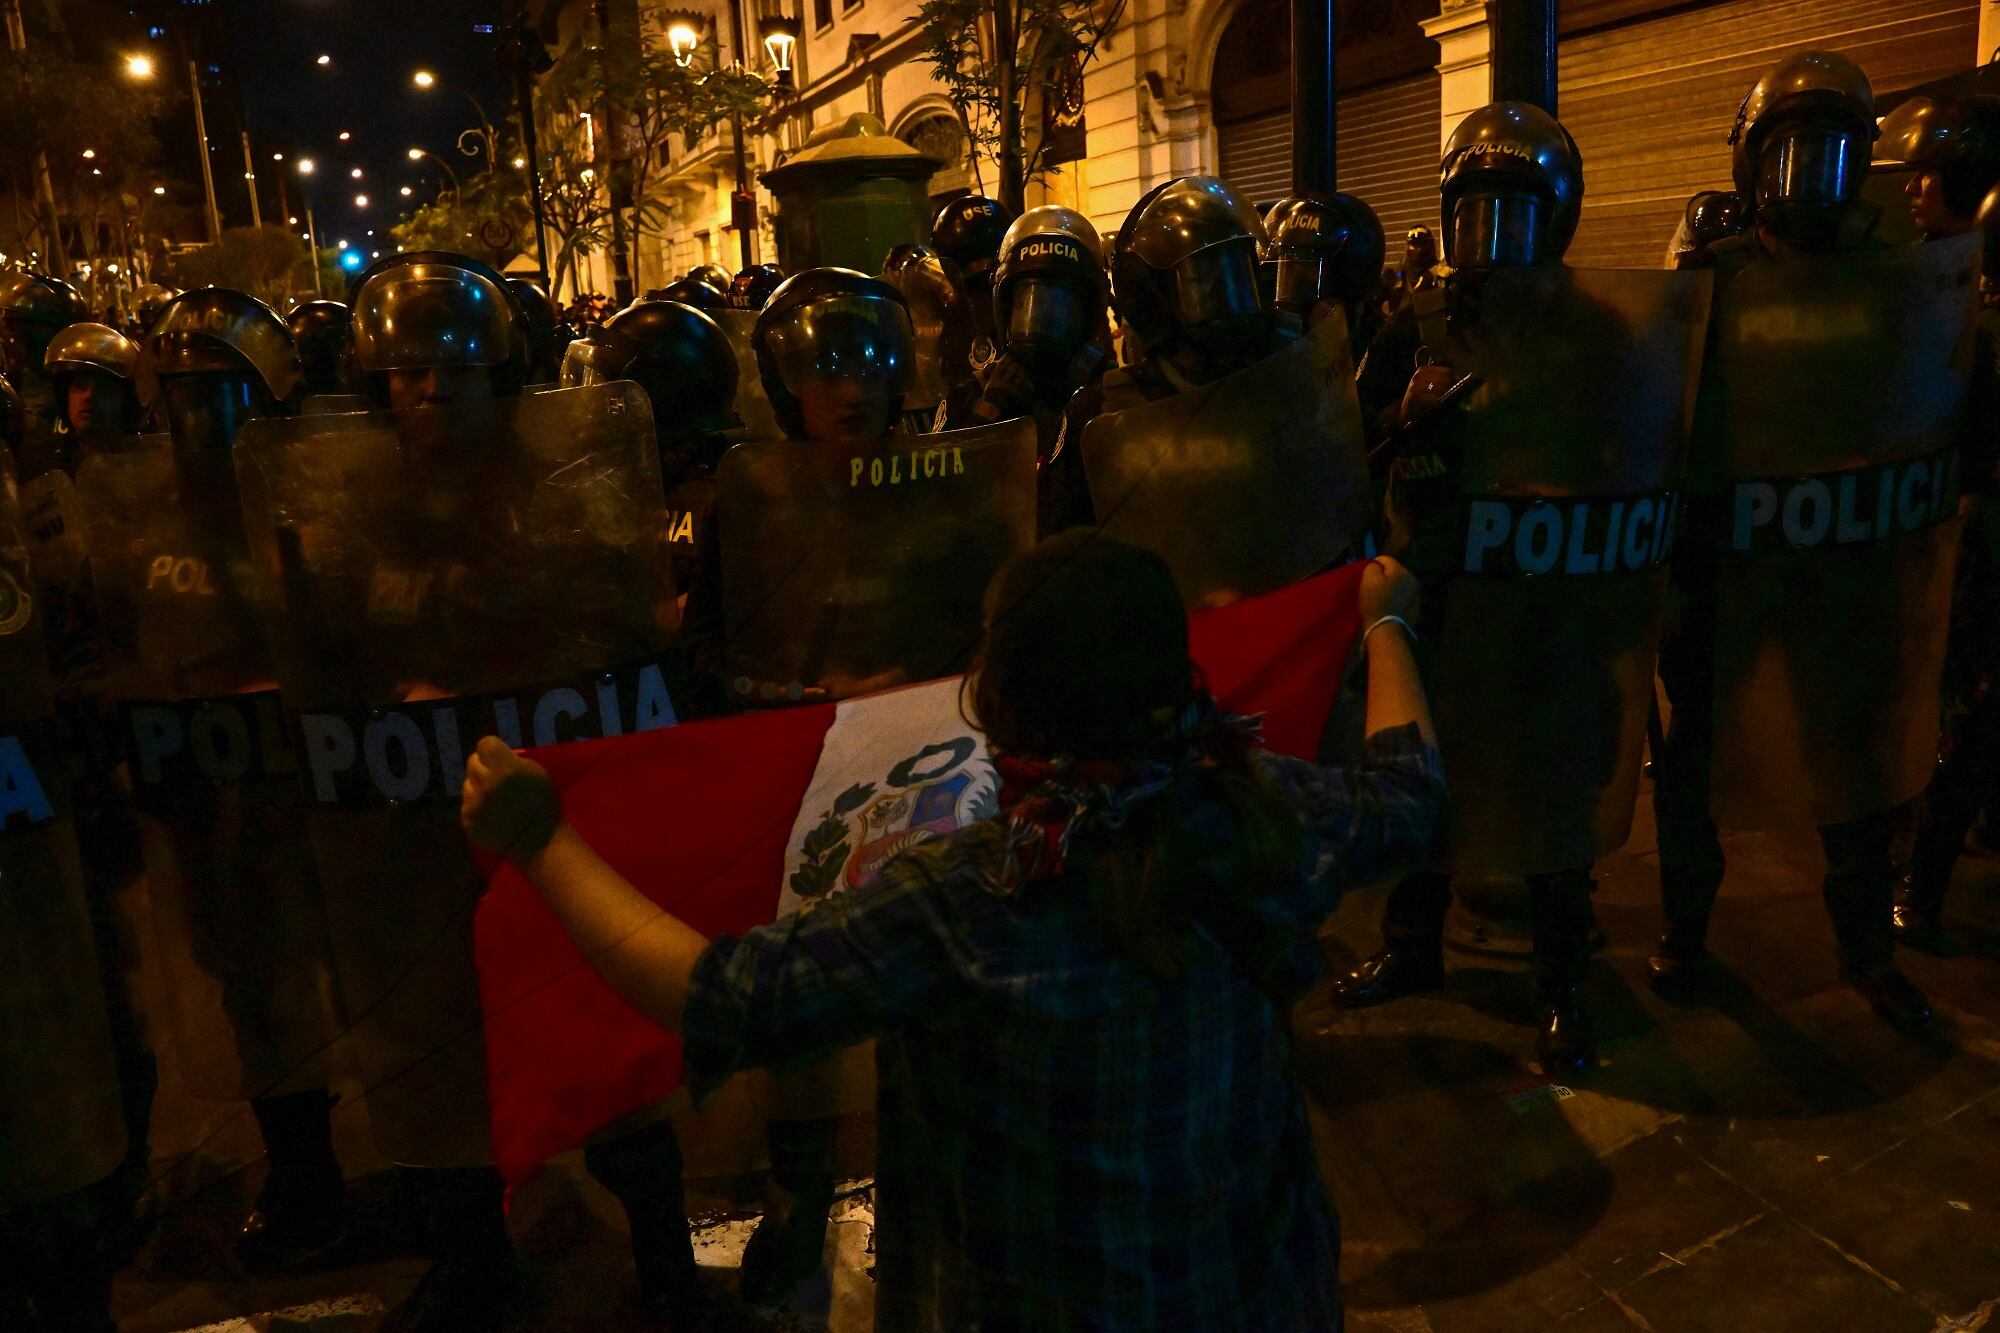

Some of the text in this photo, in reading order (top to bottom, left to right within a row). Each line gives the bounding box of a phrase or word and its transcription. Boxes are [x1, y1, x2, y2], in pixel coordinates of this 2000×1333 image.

[962, 204, 992, 221] USE
[1286, 214, 1320, 232] LICIA
[1019, 242, 1079, 262] POLICIA
[850, 446, 965, 488] POLICIA
[1732, 449, 1960, 551] POLICI
